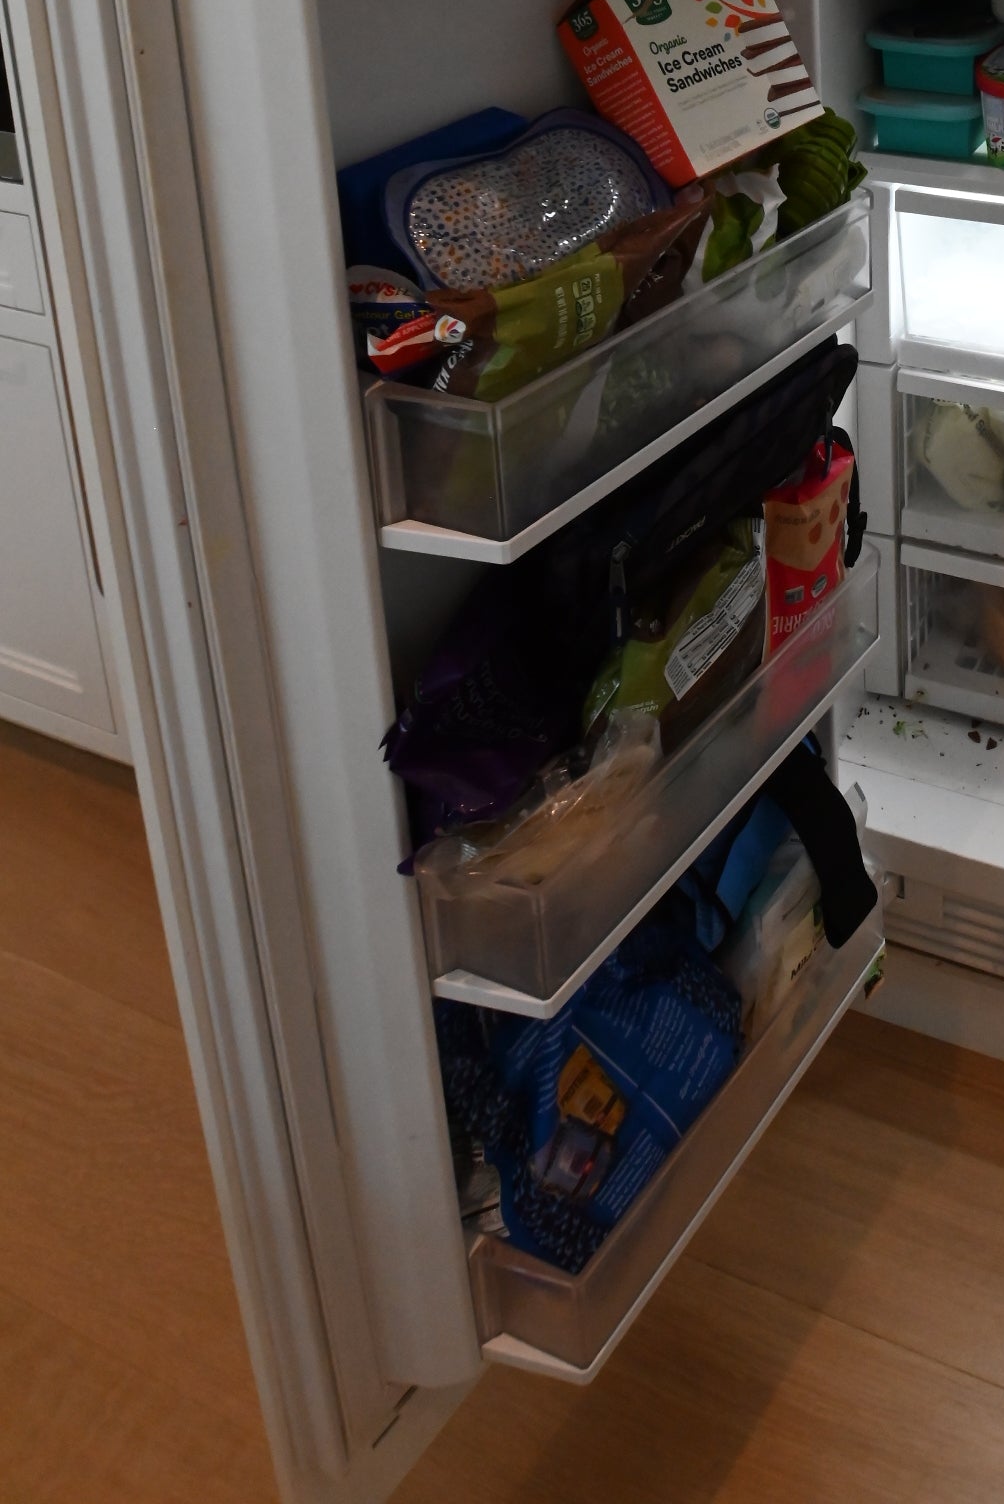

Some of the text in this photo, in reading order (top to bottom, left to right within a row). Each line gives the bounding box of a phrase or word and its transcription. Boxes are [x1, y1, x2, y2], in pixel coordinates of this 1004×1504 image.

[571, 10, 593, 34] 365
[649, 34, 688, 56] Organic
[657, 43, 726, 76] Ice Cream
[583, 47, 624, 75] Ice Cream
[586, 56, 633, 88] Sandwiches
[666, 53, 743, 93] Sandwiches
